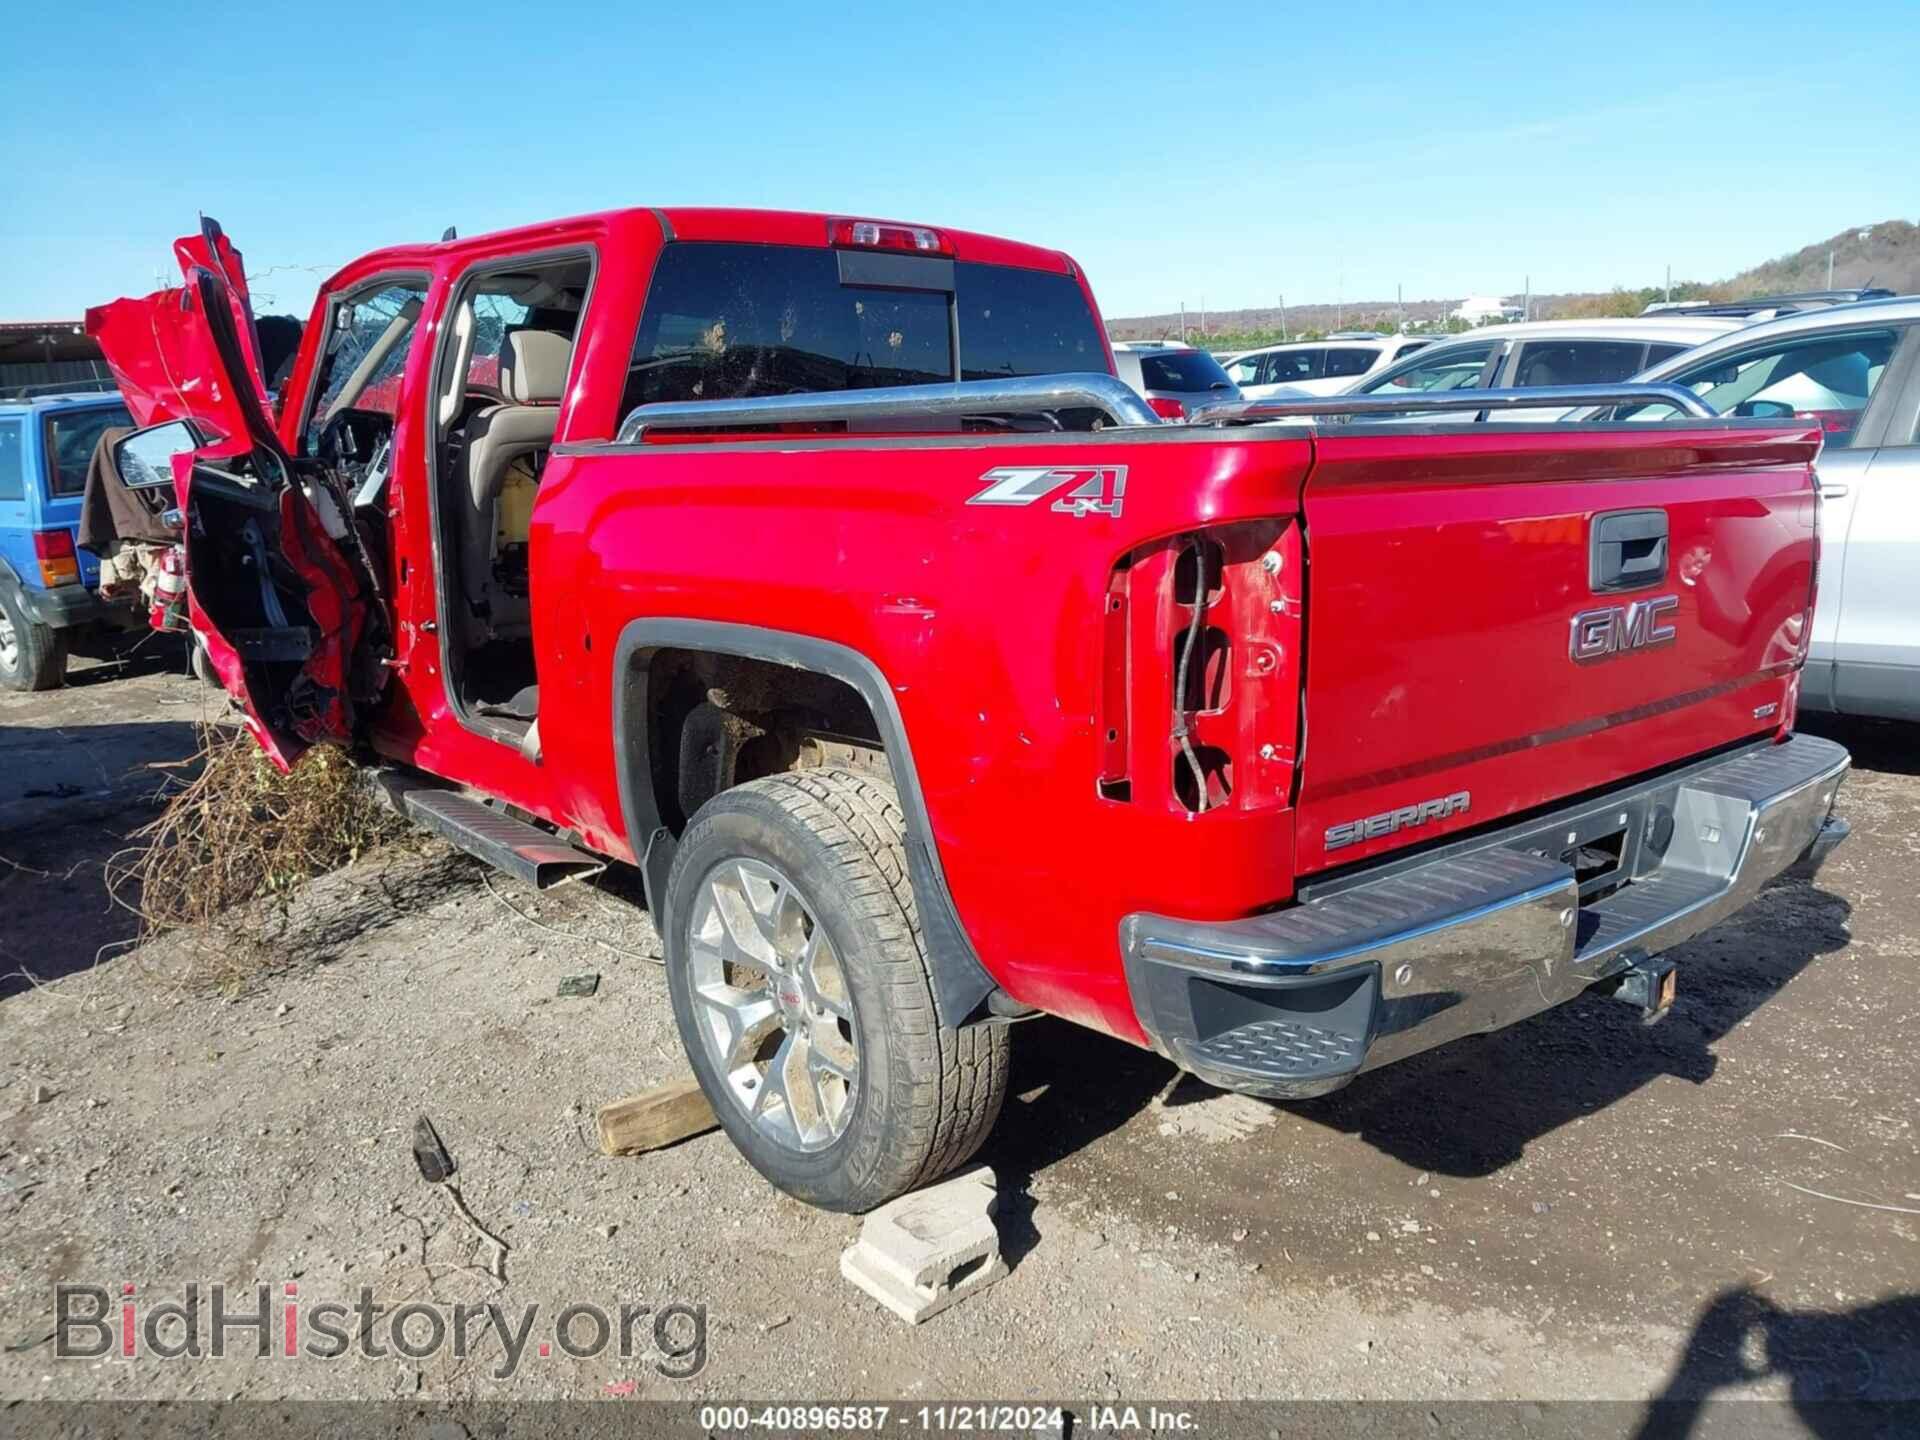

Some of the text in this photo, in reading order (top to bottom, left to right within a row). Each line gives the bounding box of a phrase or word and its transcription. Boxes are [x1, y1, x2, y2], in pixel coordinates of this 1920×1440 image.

[965, 465, 1128, 506] Z71
[1569, 594, 1679, 662] GMC
[1324, 790, 1471, 850] SIERRA
